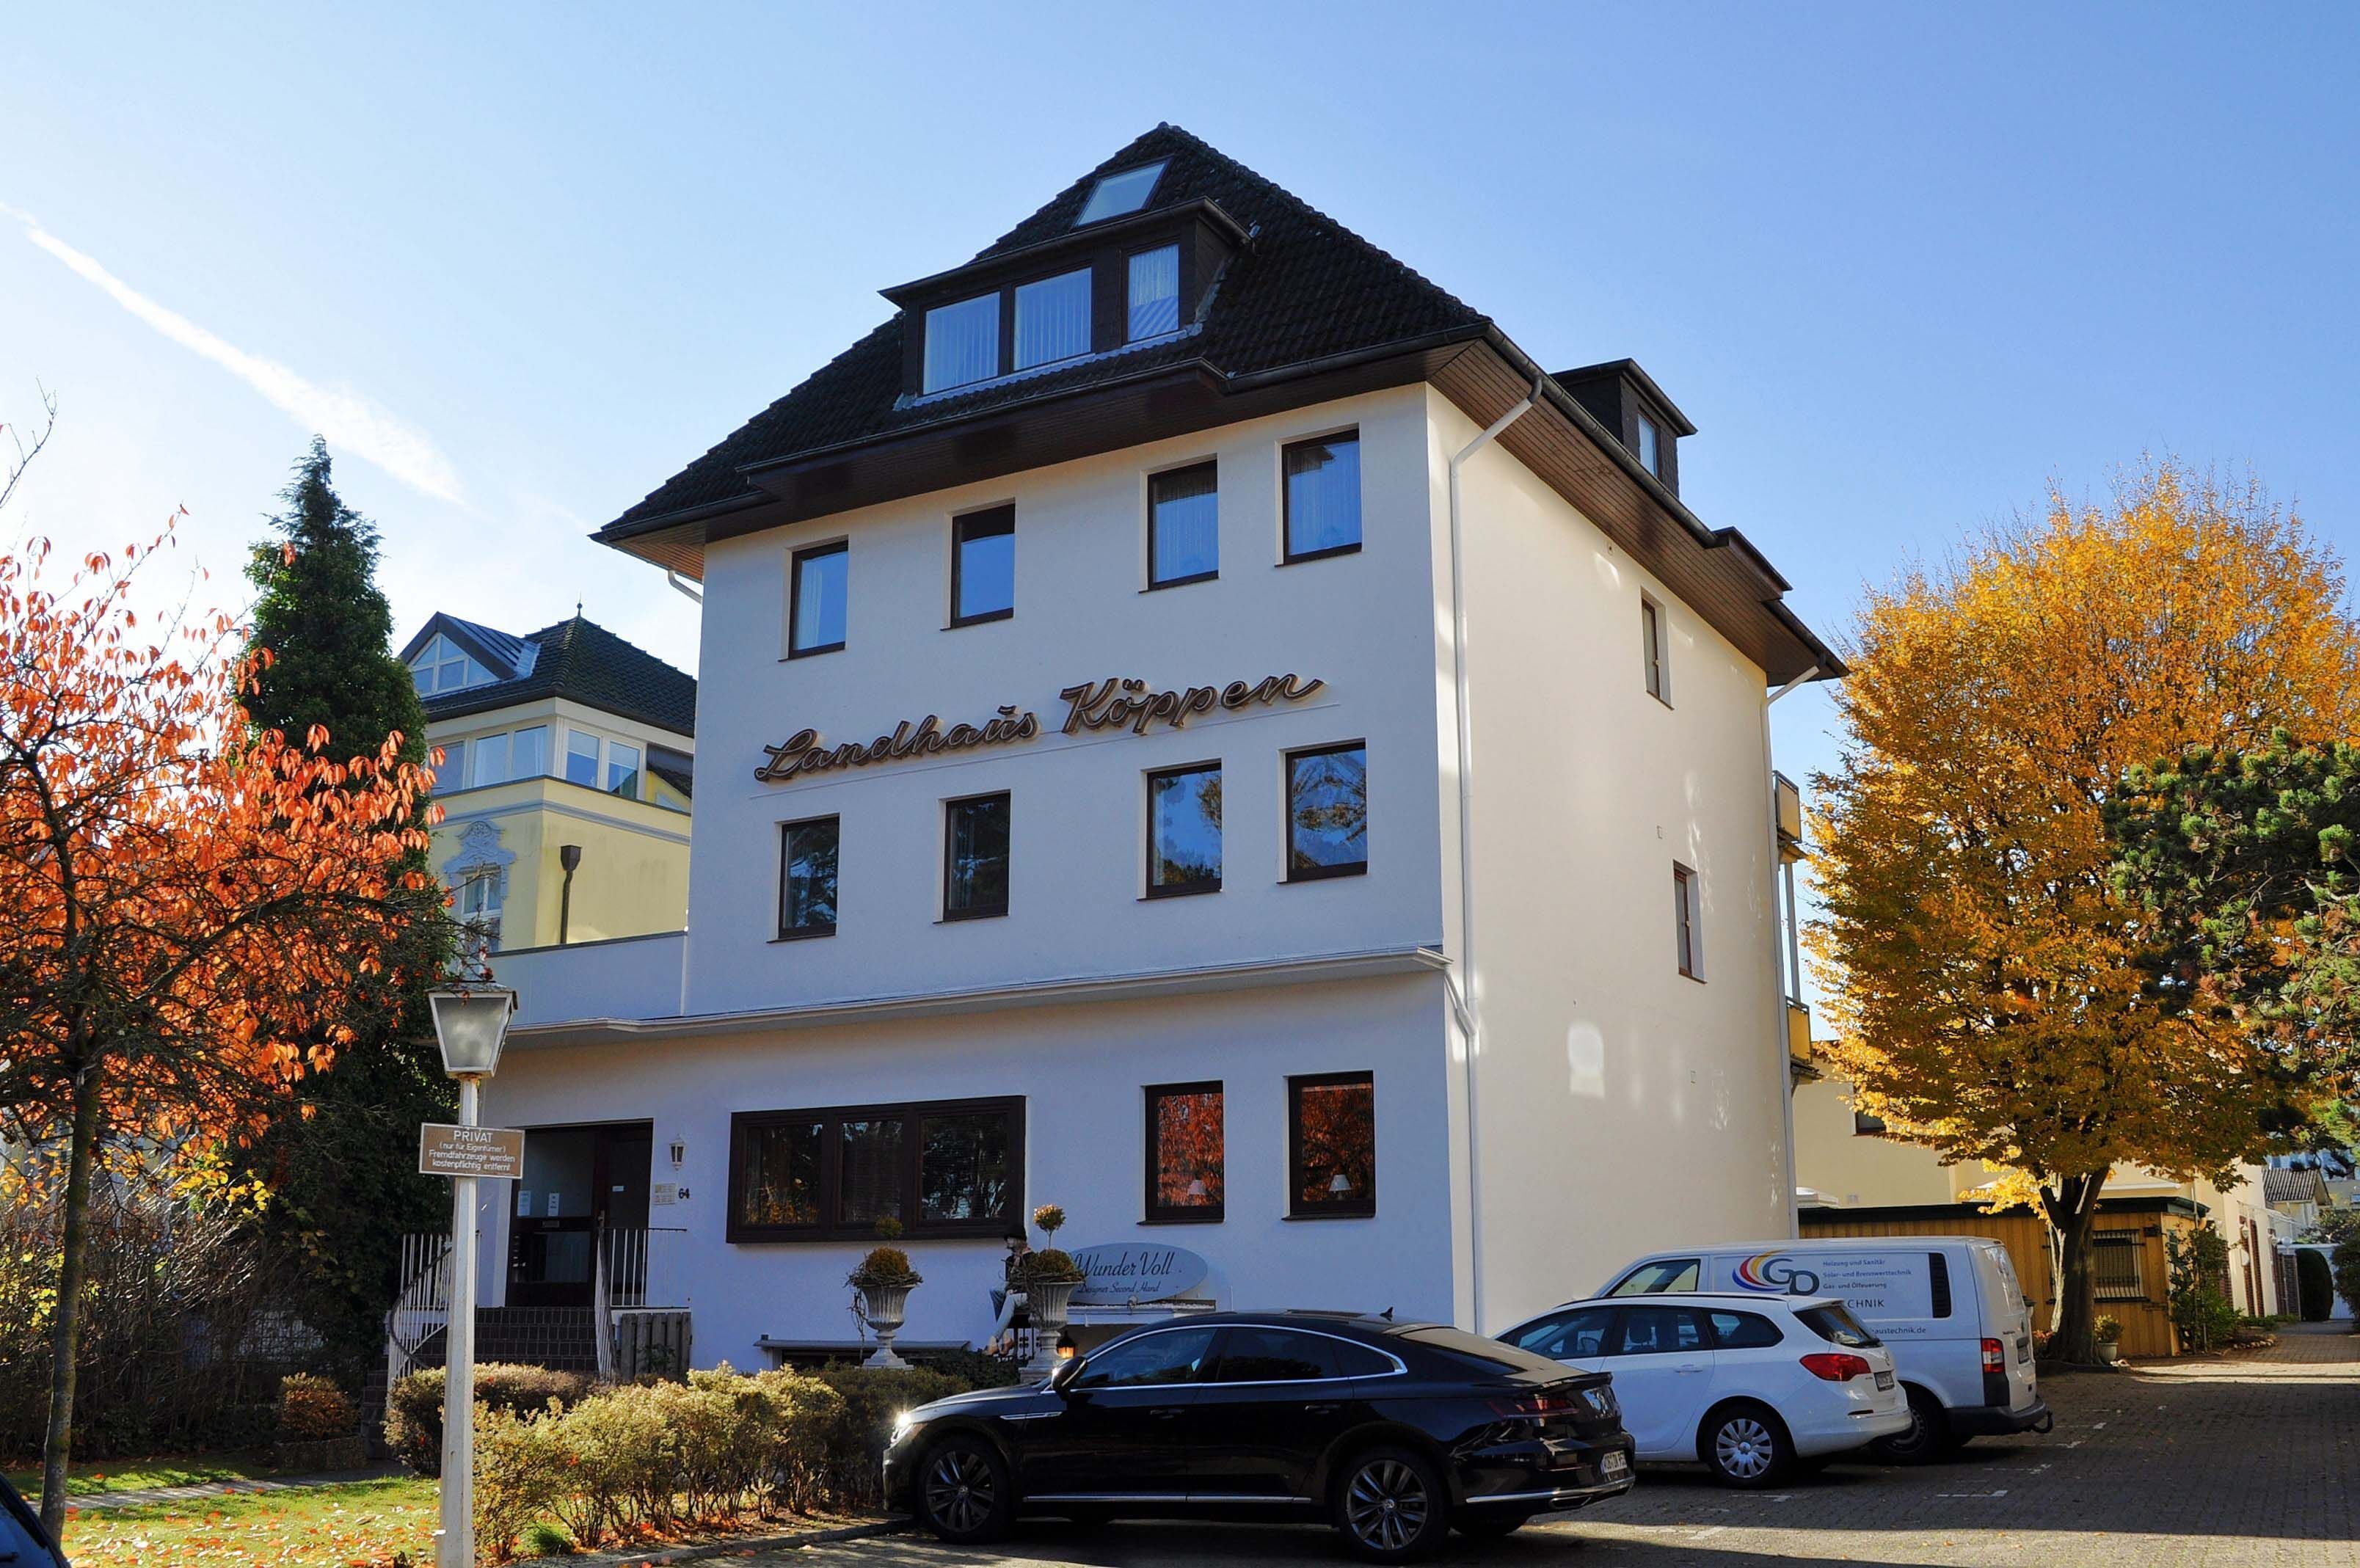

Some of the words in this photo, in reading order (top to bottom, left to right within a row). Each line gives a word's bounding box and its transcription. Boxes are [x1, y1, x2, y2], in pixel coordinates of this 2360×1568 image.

[753, 704, 1040, 782] Landhaus
[1059, 672, 1327, 734] Köppen
[453, 1130, 493, 1143] PRIVAT
[429, 1149, 487, 1162] Fremdfahrzeuge
[489, 1154, 515, 1162] werden
[432, 1159, 481, 1171] kostenpflichtig
[484, 1163, 511, 1171] entfernt
[678, 1187, 691, 1200] 64
[1074, 1251, 1137, 1277] Wunder
[1140, 1251, 1175, 1276] Voll
[1077, 1283, 1109, 1296] Designer
[1109, 1281, 1137, 1293] Second
[1137, 1281, 1161, 1293] Hand
[1847, 1299, 1884, 1308] CHNIK
[1872, 1326, 1926, 1334] austechnik.de
